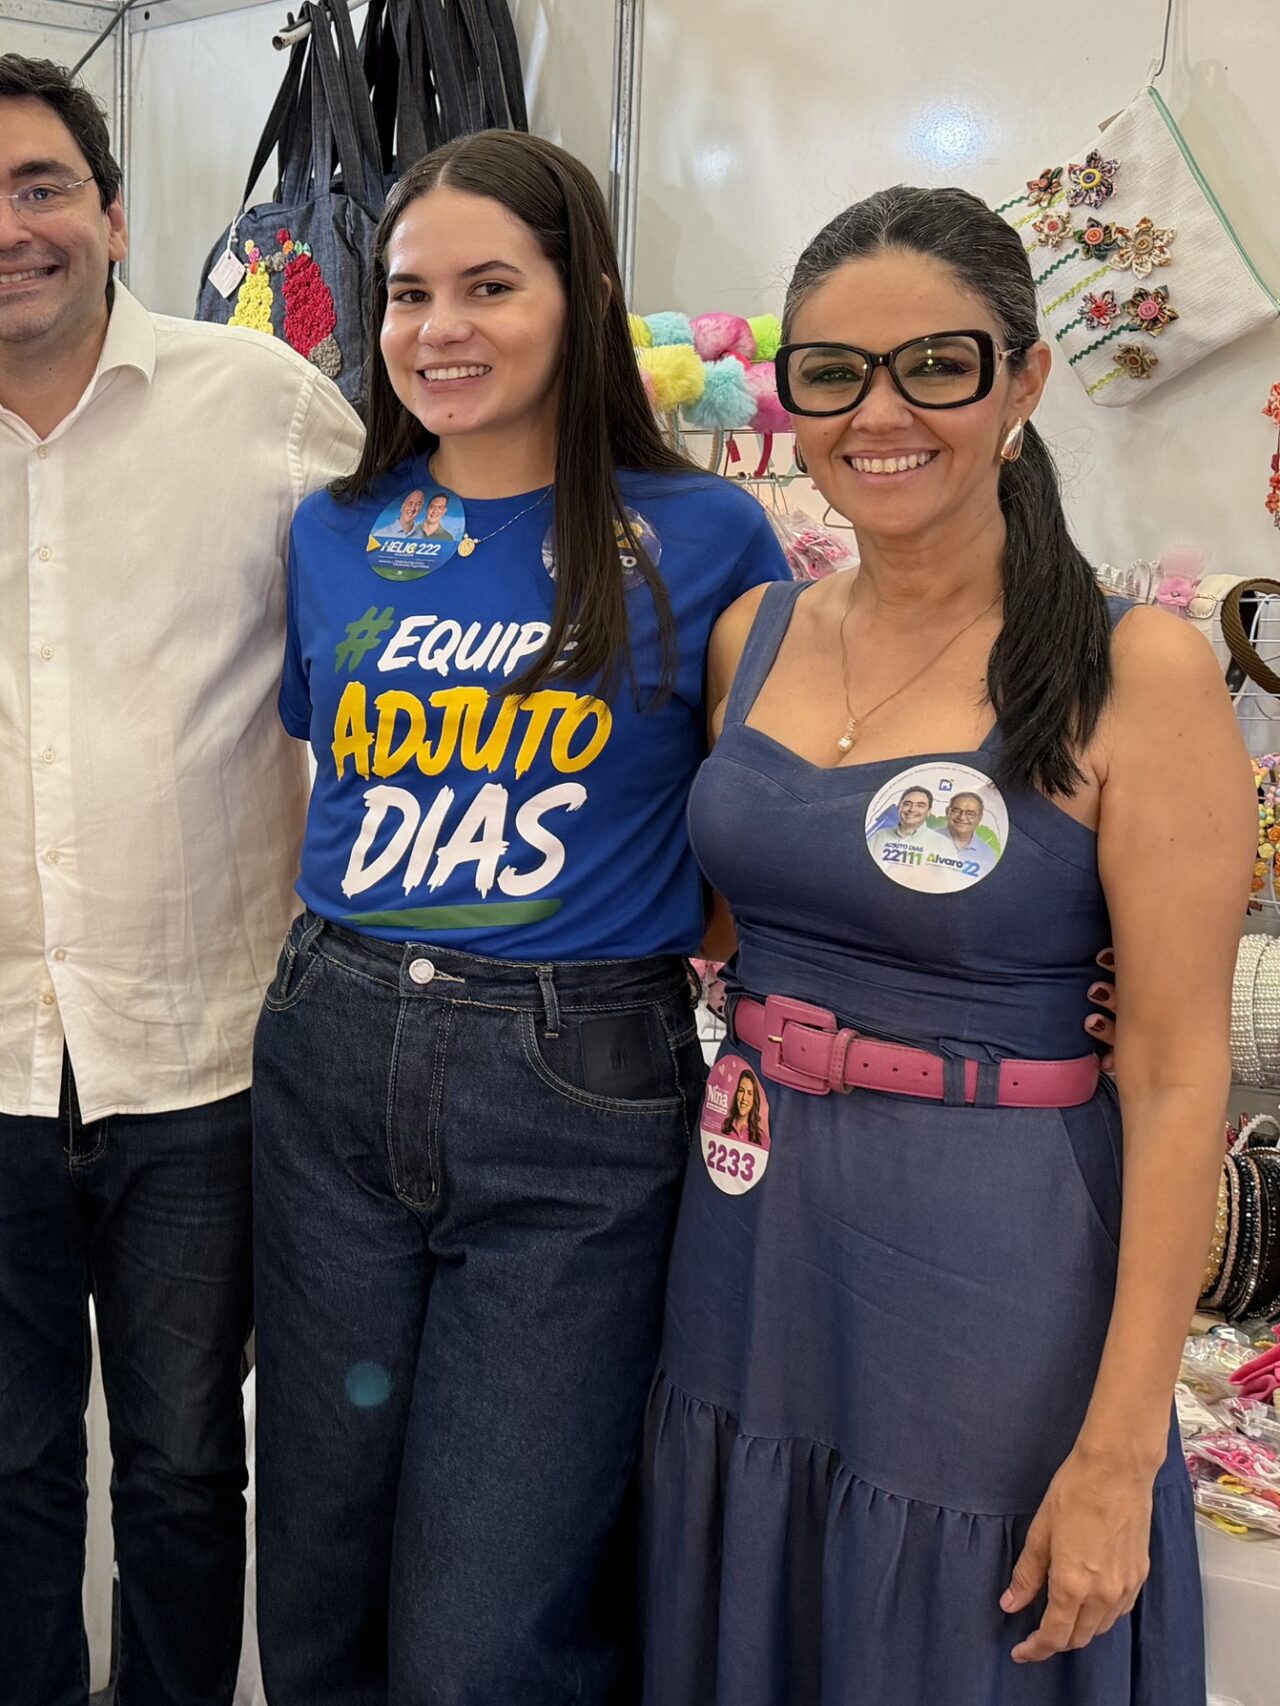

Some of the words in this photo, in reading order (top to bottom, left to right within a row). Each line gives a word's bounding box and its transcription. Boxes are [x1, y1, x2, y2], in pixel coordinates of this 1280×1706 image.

[335, 605, 580, 677] #EQUIP
[332, 681, 614, 782] ADJUTO
[341, 782, 588, 899] DIAS
[882, 849, 923, 865] 22111
[884, 842, 908, 850] ADJUTO
[908, 845, 924, 853] DIAS
[707, 1084, 729, 1108] Nina
[706, 1140, 756, 1183] 2233
